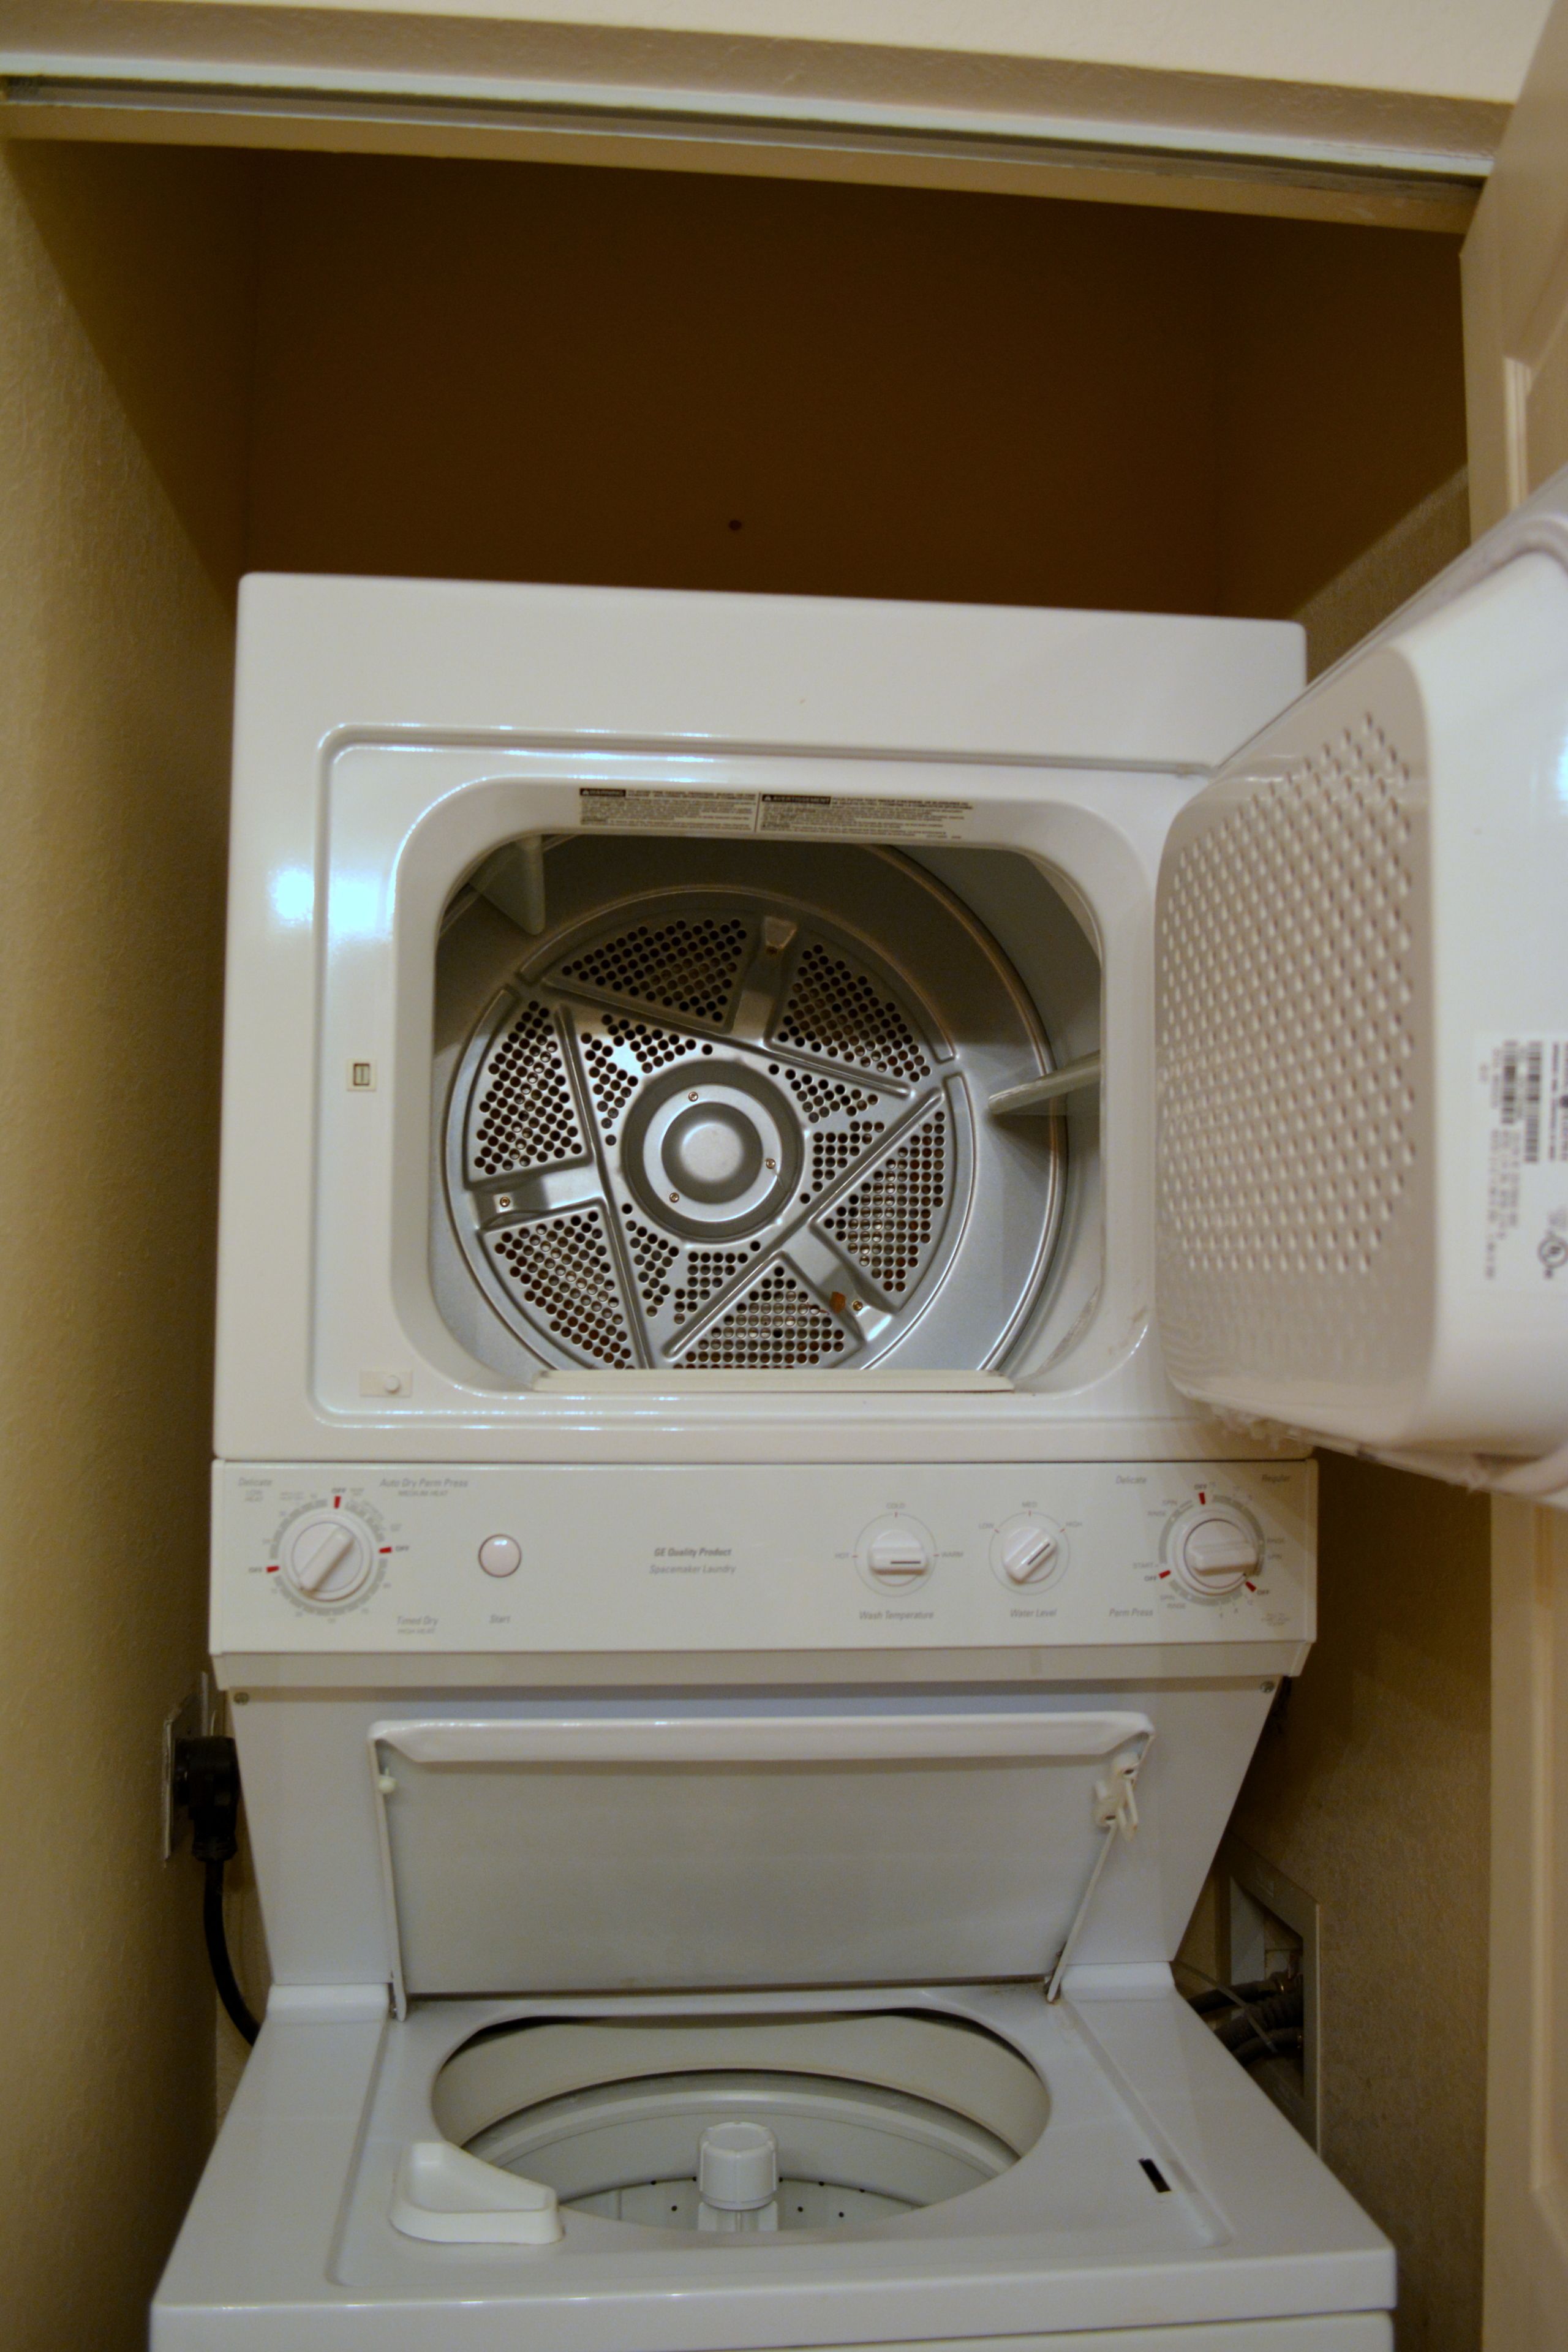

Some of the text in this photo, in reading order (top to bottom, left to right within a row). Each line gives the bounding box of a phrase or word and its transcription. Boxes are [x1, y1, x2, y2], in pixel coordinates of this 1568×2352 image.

[238, 1477, 273, 1487] Delicate
[379, 1478, 469, 1488] Auto Dry Perm Press
[1115, 1476, 1147, 1484] Delicate
[654, 1547, 732, 1558] GE Quality Product
[649, 1564, 737, 1575] Spacemaker Laundry
[859, 1610, 934, 1621] Wash Temperature
[1010, 1608, 1058, 1618] Water Level
[1109, 1608, 1153, 1617] Perm Press
[396, 1615, 439, 1626] Timed Dry
[489, 1614, 511, 1624] Start
